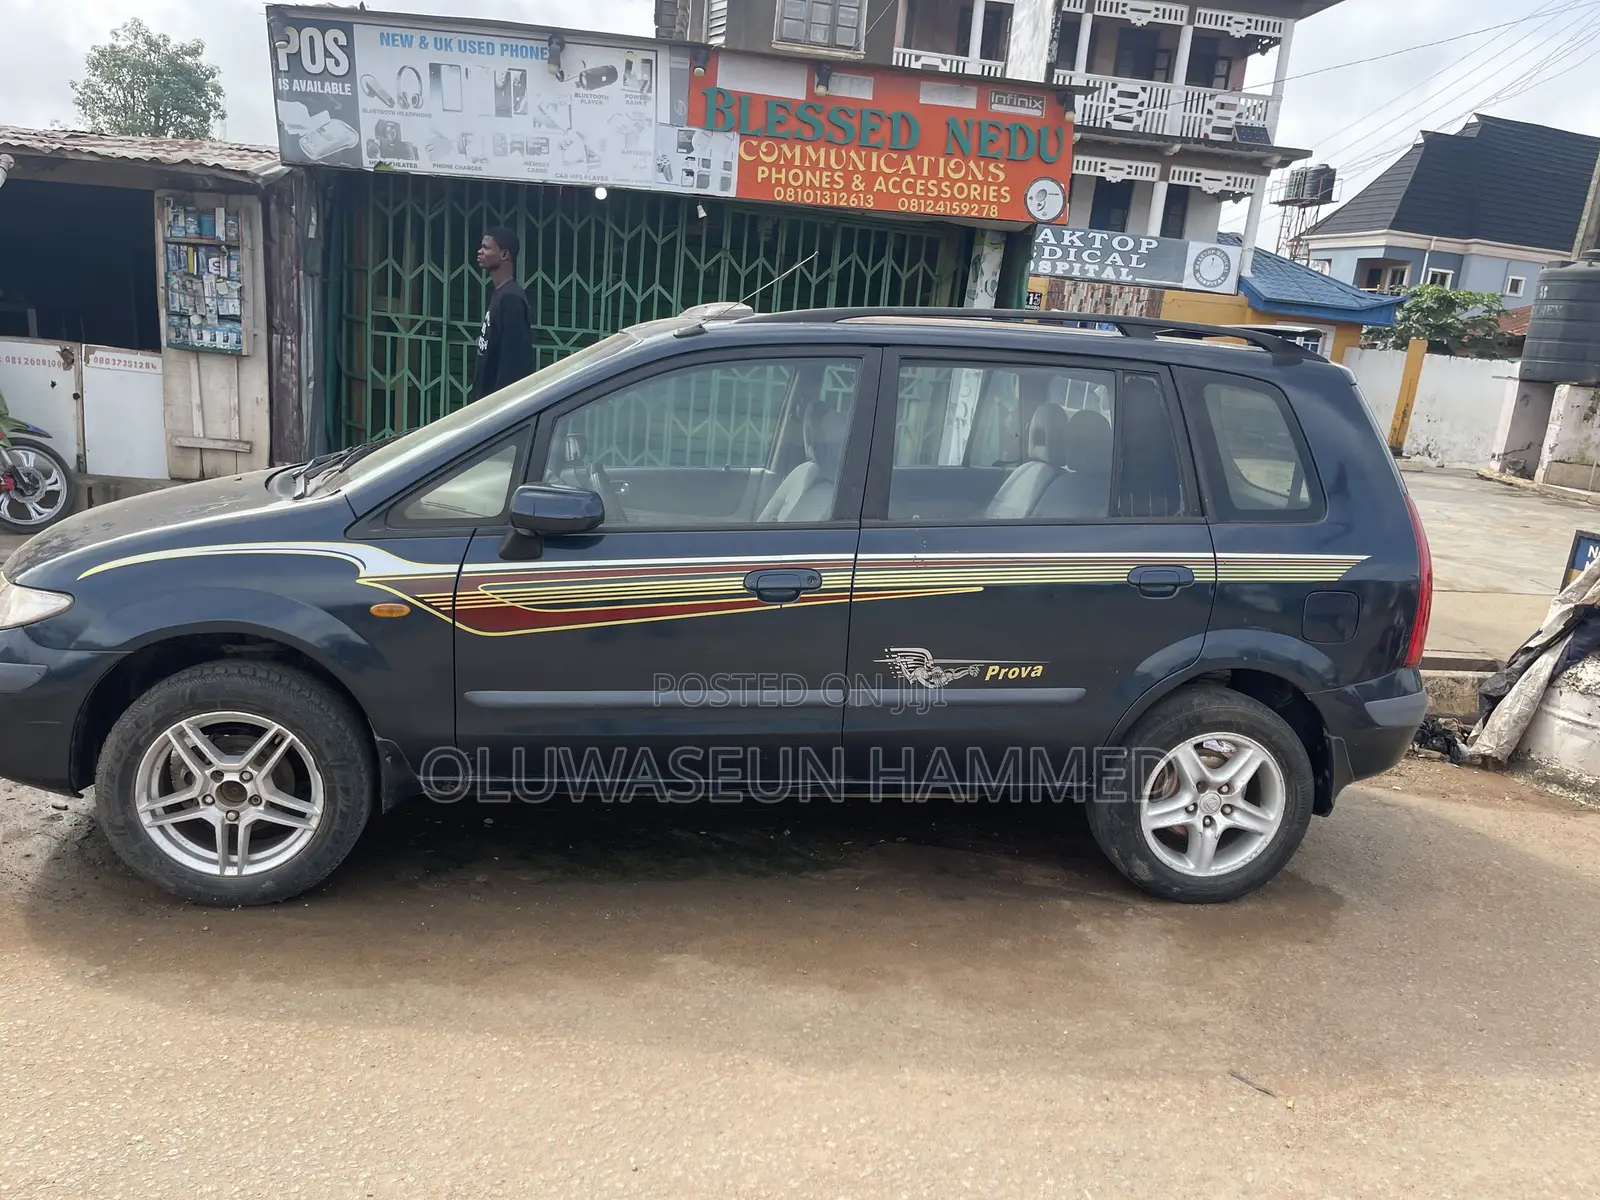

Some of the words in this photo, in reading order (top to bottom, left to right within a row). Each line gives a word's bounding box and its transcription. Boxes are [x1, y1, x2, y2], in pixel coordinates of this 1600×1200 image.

[277, 25, 350, 76] POS
[379, 32, 414, 49] NEW
[418, 35, 429, 50] &
[433, 37, 453, 53] UK
[458, 39, 496, 56] USED
[278, 78, 290, 91] IS
[292, 79, 352, 96] AVAILABLE
[574, 92, 609, 100] BLUETOOTH
[991, 91, 1043, 109] Infinix
[702, 86, 920, 151] BLESSED
[945, 116, 1064, 164] NEDU
[739, 140, 1006, 183] COMMUNICATIONS
[584, 174, 609, 182] PLAYER
[756, 166, 845, 191] PHONES
[850, 173, 866, 192] &
[873, 175, 1011, 204] ACCESSORIES
[773, 186, 875, 209] 08101312613
[897, 197, 999, 219] 08124159278
[984, 665, 1043, 681] Prova
